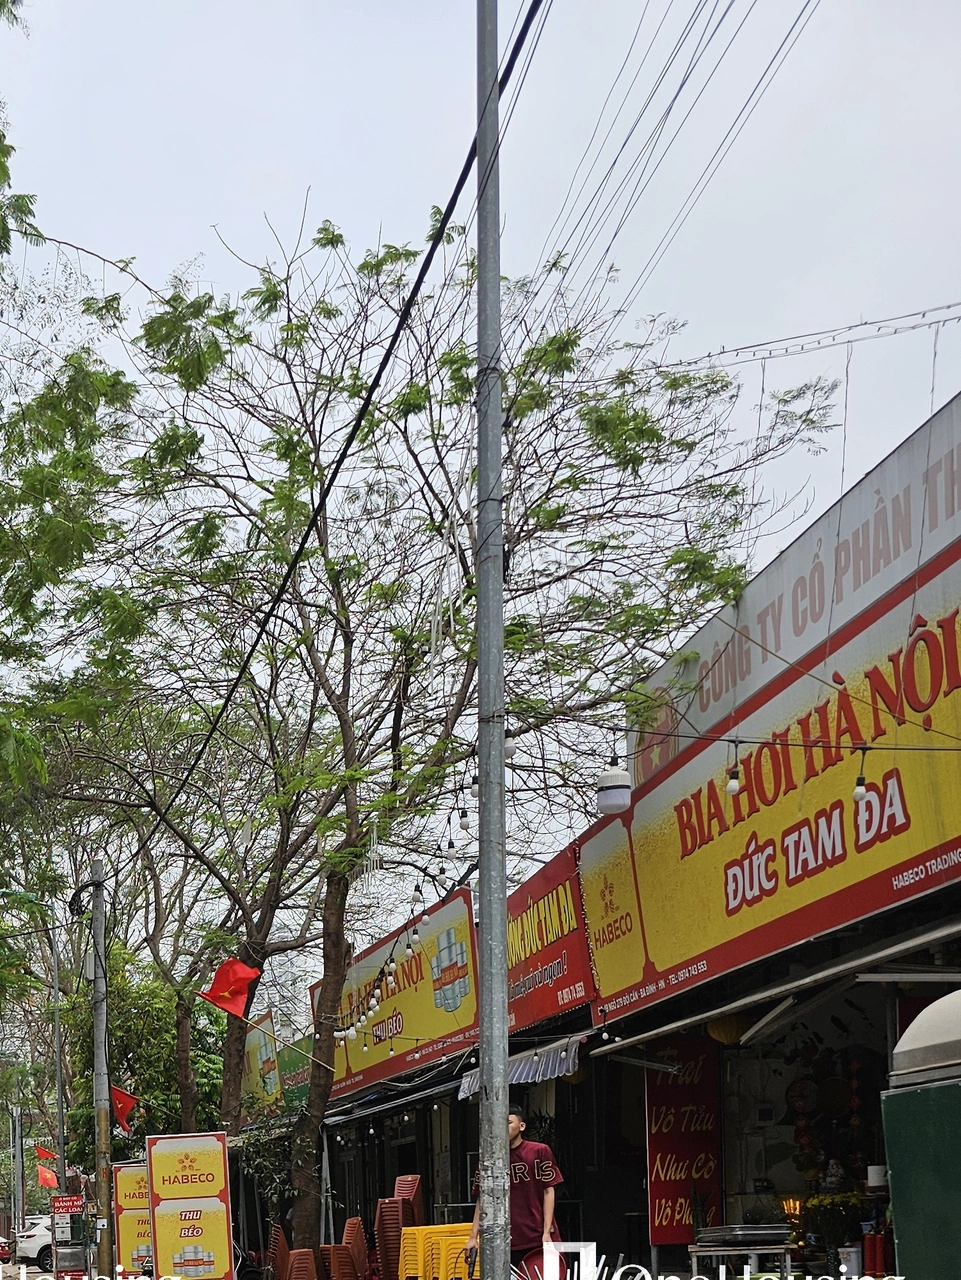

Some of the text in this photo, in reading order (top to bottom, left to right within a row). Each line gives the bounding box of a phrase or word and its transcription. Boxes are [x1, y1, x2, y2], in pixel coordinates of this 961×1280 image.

[697, 624, 752, 714] CÔNG
[757, 592, 784, 665] TY
[791, 537, 825, 638] CỔ
[834, 484, 912, 605] PHẦN
[674, 778, 730, 860] BIA
[797, 670, 866, 783] HÀ
[864, 606, 961, 742] NỘI
[726, 775, 907, 911] ĐỨC TAM ĐA
[892, 848, 961, 890] HABECO TRADING
[538, 889, 561, 947] TAM
[558, 879, 578, 936] ĐA
[593, 912, 633, 951] HABECO
[387, 1009, 403, 1037] BÉO
[651, 1106, 675, 1134] Vô
[162, 1172, 215, 1185] HABECO
[651, 1152, 717, 1181] Như Cờ
[180, 1210, 202, 1221] THU
[654, 1196, 716, 1228] Vô Phg
[180, 1224, 203, 1237] BÉO
